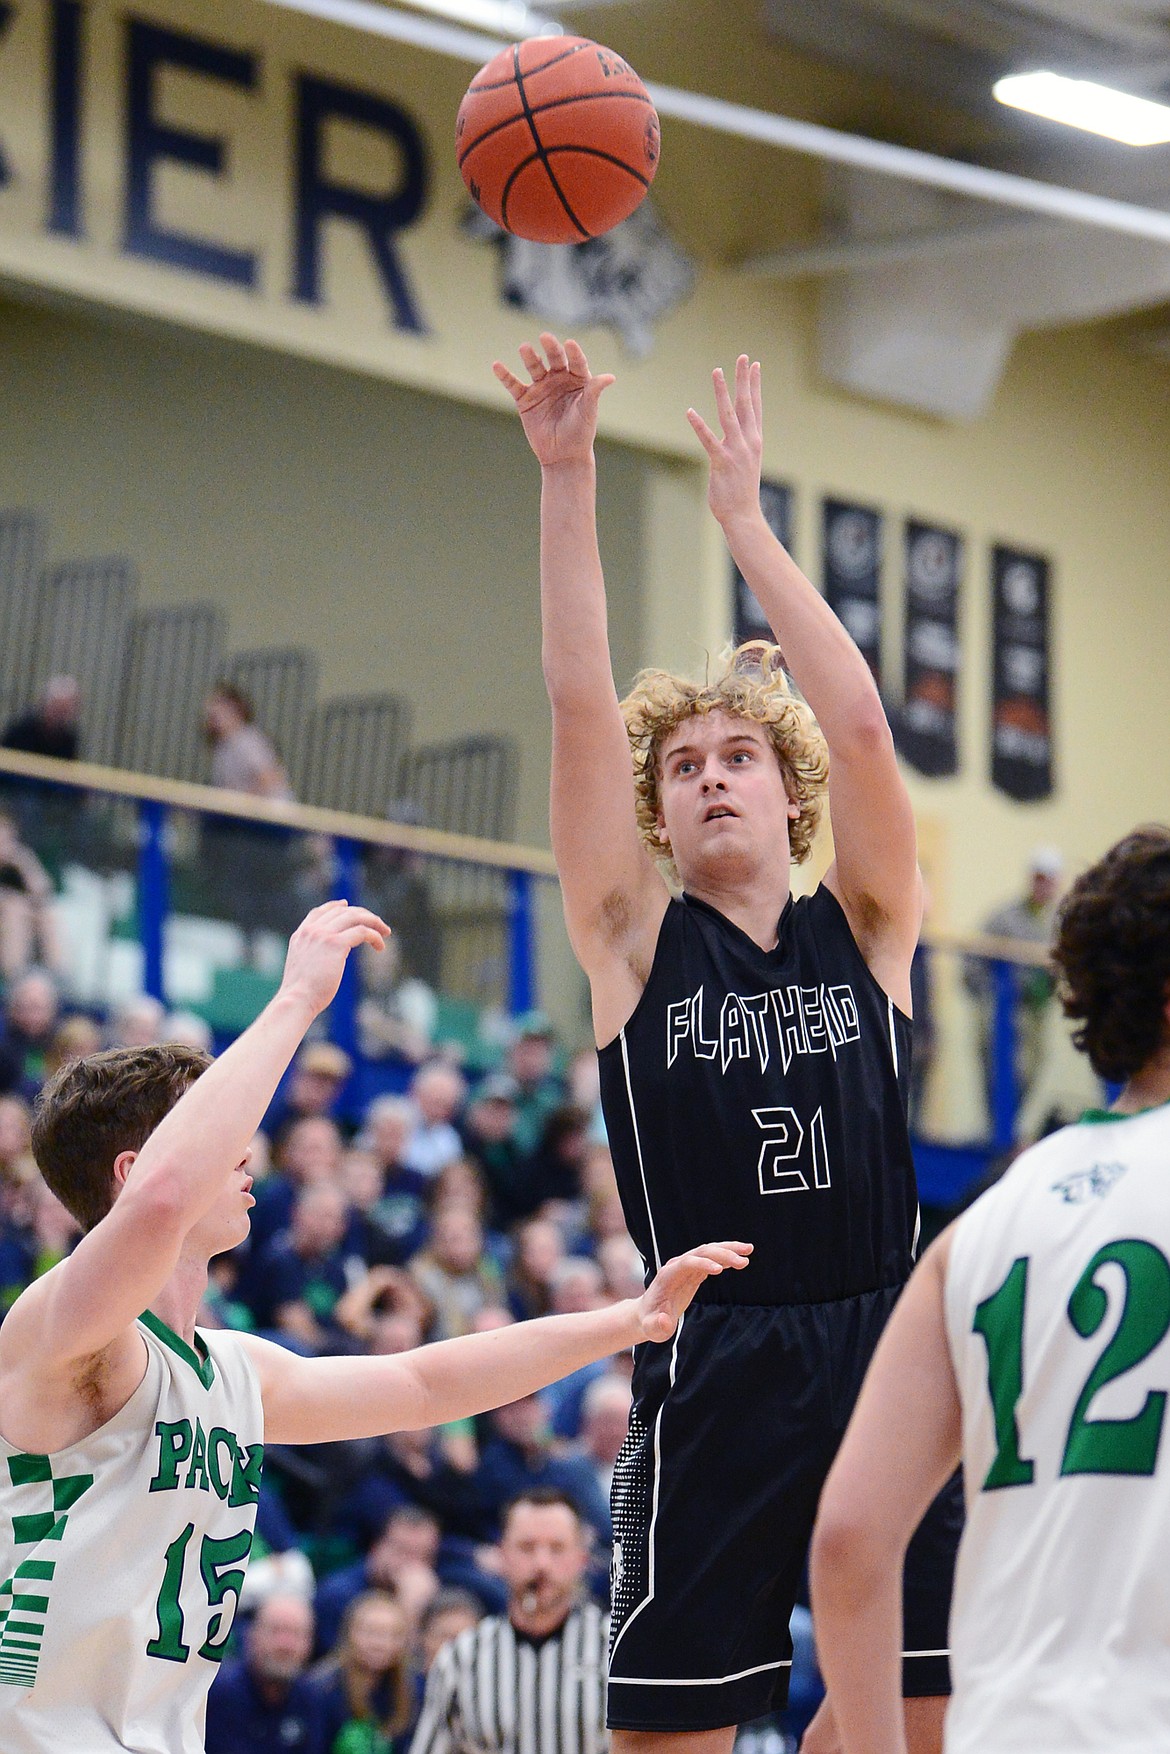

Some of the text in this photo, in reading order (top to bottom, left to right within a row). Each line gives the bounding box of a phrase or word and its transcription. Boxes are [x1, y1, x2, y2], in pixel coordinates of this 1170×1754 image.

[0, 0, 430, 337] IER
[751, 1105, 831, 1195] 21
[972, 1239, 1170, 1492] 12
[149, 1416, 264, 1507] PACK
[146, 1522, 253, 1663] 15
